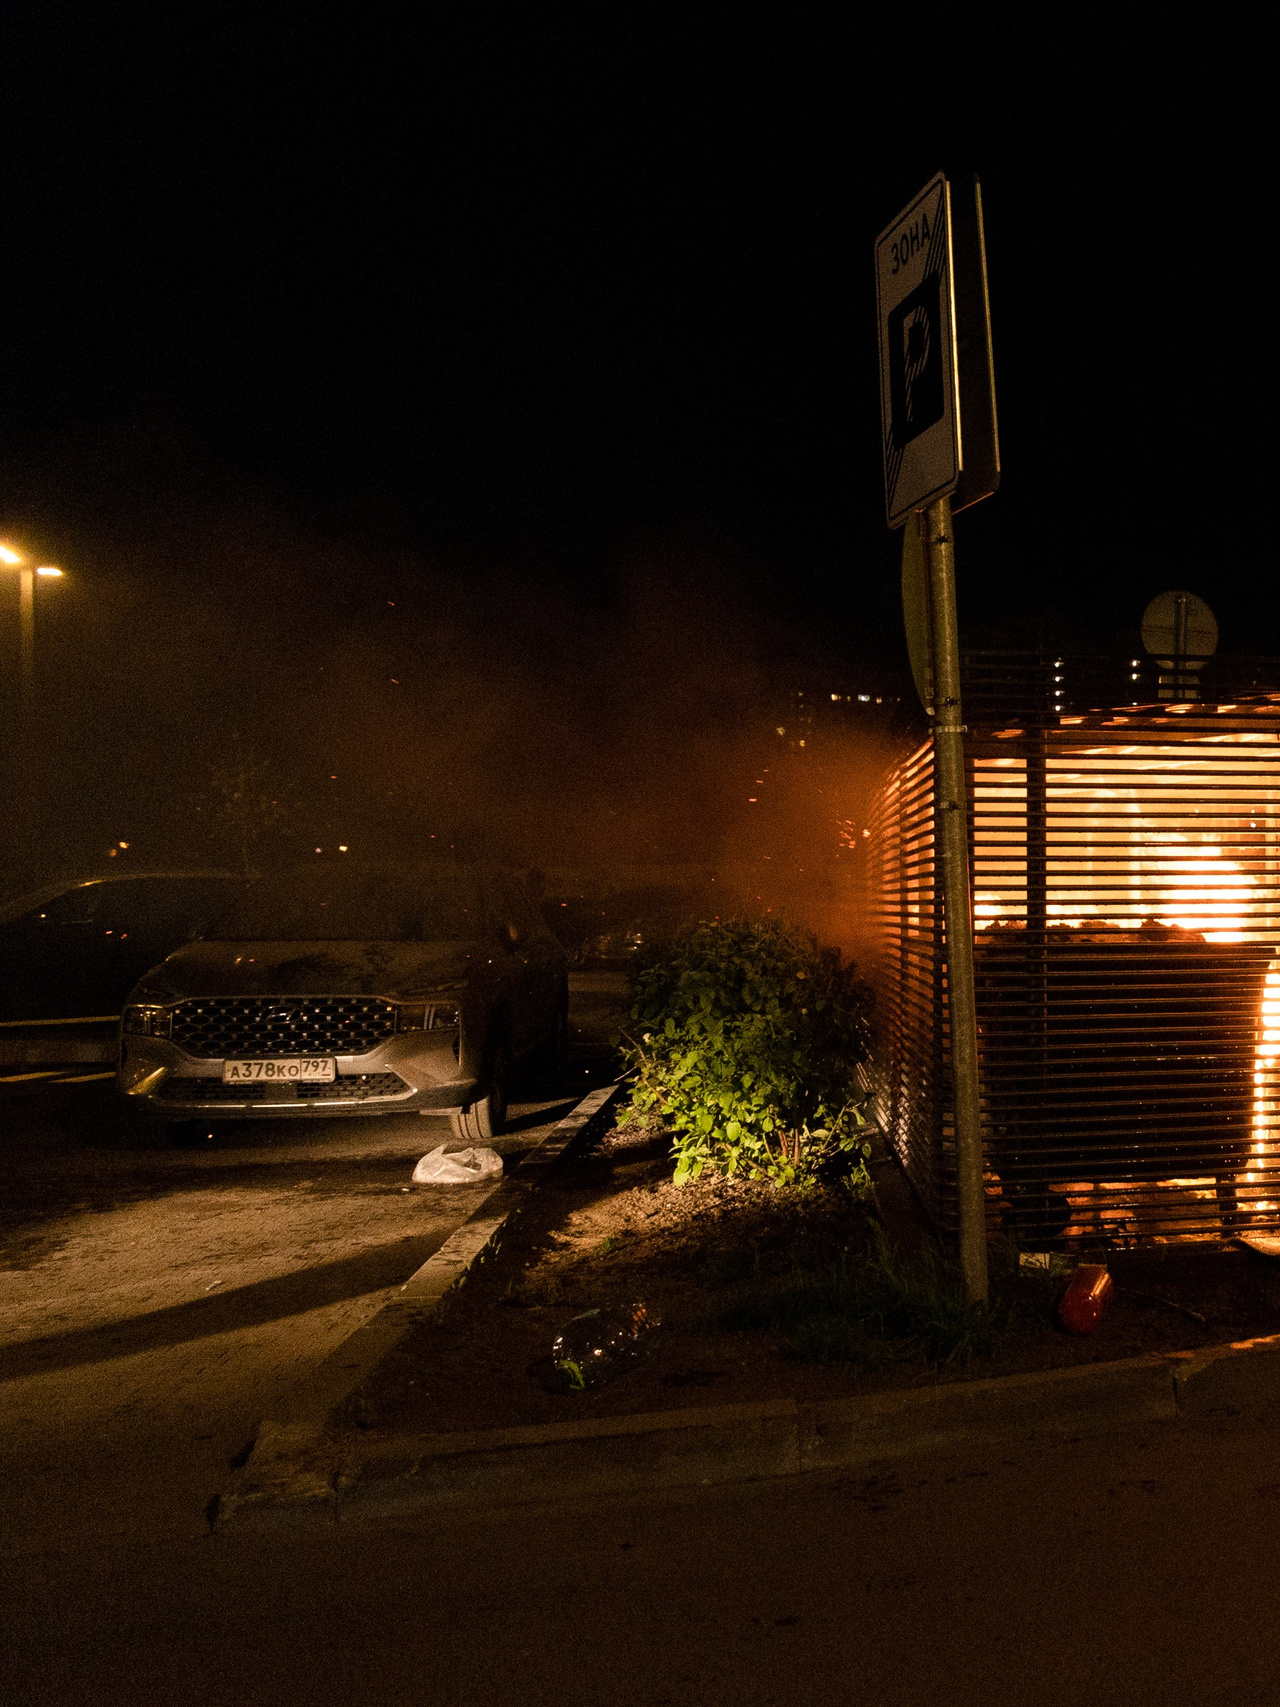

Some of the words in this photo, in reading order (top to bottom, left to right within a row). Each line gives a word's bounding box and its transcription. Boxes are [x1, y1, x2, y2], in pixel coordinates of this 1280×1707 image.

[891, 212, 931, 275] ЗОНА
[230, 1062, 299, 1079] А378КО
[302, 1060, 328, 1072] 797
